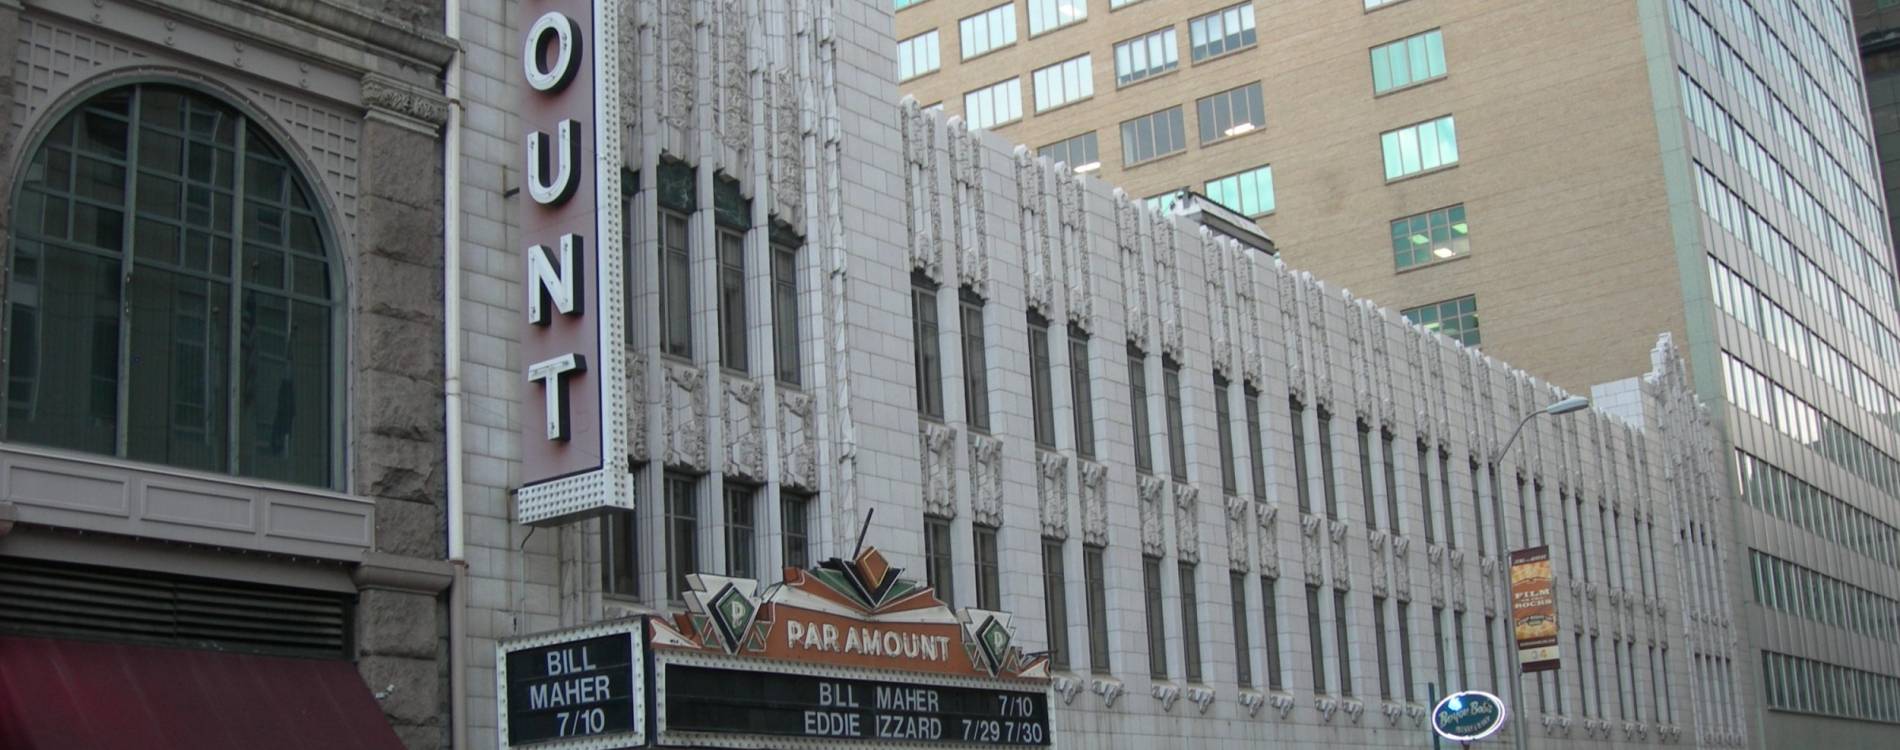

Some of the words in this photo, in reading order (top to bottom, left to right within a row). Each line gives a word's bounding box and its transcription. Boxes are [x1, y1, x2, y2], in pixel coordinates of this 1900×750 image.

[1514, 588, 1550, 600] FILM
[1514, 599, 1552, 609] ROCKS
[787, 620, 950, 662] PARAMOUNT
[547, 645, 597, 676] BILL
[529, 675, 611, 710] MAHER
[876, 686, 940, 713] MAHER
[999, 695, 1033, 717] 7/10
[557, 707, 606, 737] 7/10
[804, 711, 862, 737] EDDIE
[875, 715, 943, 740] IZZARD
[962, 719, 1001, 741] 7/29
[1005, 721, 1043, 744] 7/30
